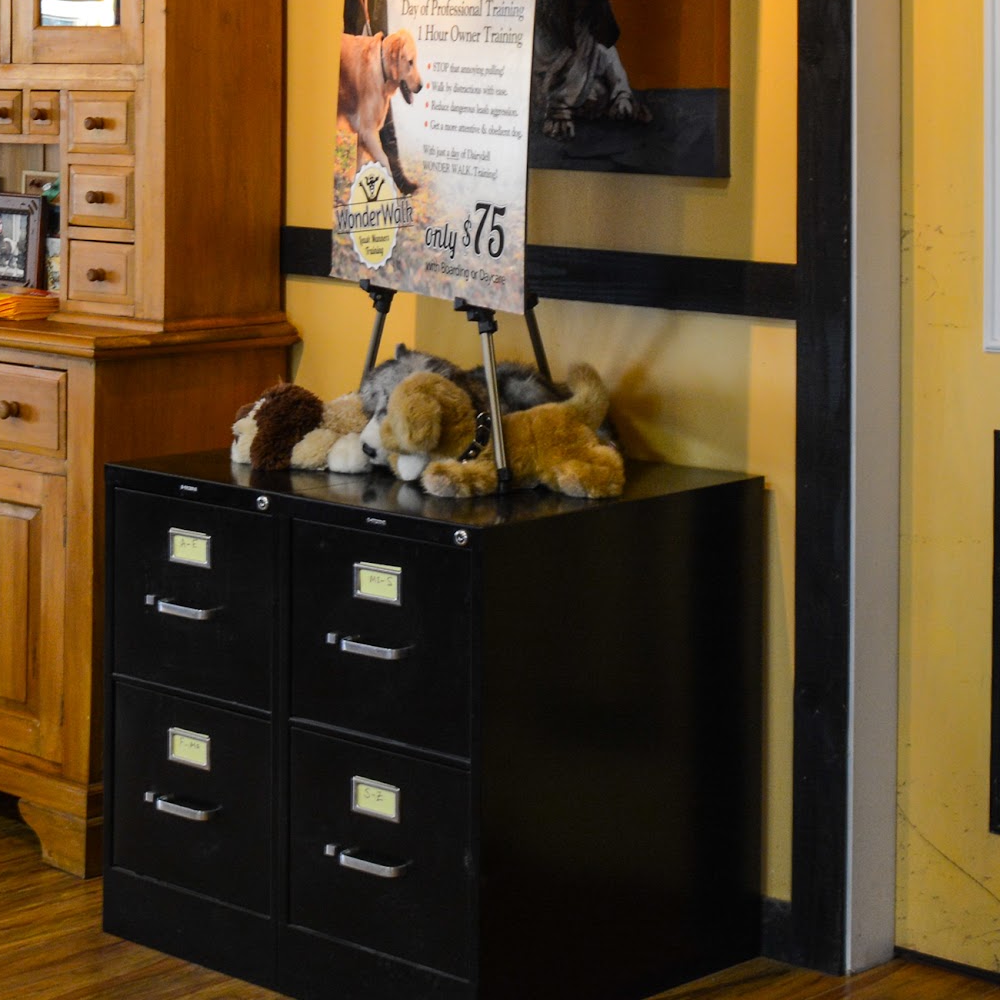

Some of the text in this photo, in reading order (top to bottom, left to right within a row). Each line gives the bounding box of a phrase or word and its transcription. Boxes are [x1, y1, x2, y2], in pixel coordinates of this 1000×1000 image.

[401, 0, 525, 21] Day of Professional Training
[418, 24, 524, 48] 1 Hour Owner Training
[432, 62, 449, 73] STOP
[423, 160, 450, 173] WONDER
[337, 201, 414, 229] WonderWalk
[425, 202, 507, 259] only $75
[440, 262, 469, 281] Boarding
[471, 270, 478, 280] or
[479, 269, 506, 286] Daycare
